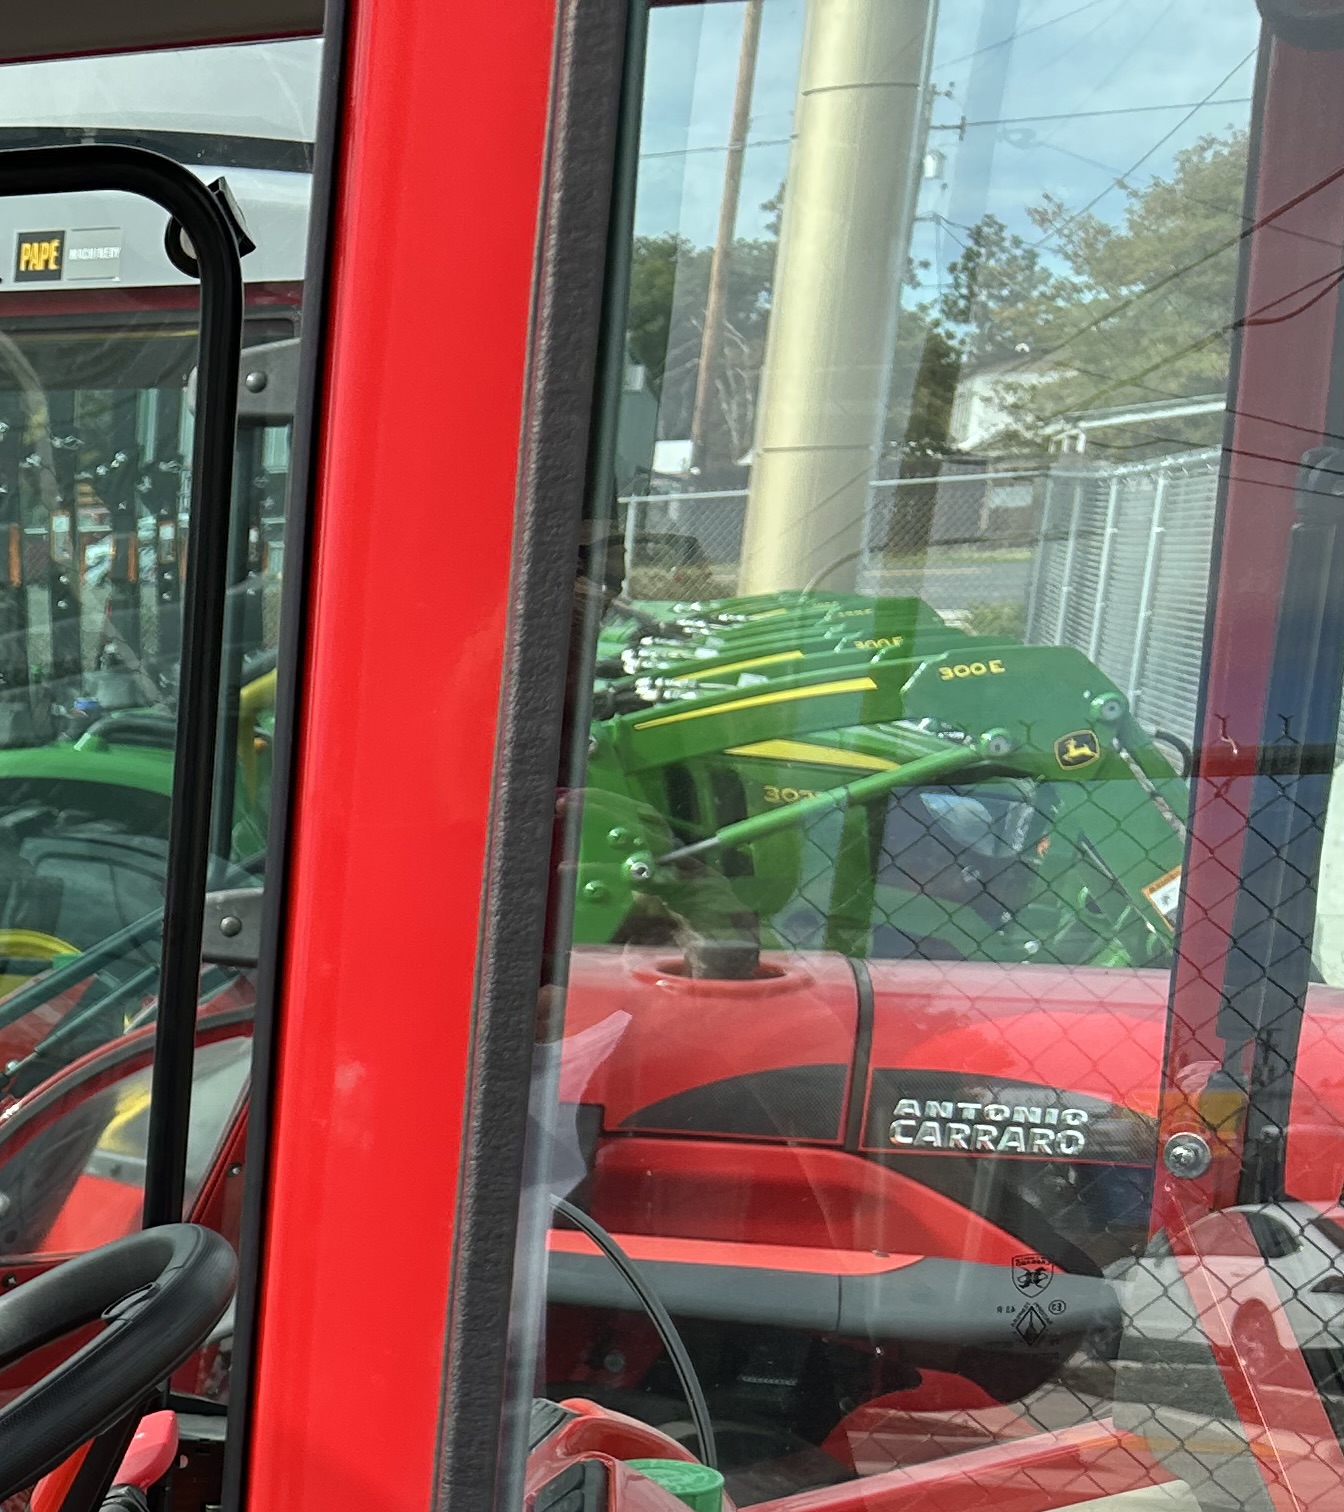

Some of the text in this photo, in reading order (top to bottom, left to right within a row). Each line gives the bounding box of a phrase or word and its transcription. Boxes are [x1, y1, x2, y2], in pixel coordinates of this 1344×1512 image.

[938, 659, 1006, 681] 300E
[893, 1098, 1088, 1127] ANTONIO
[889, 1119, 1086, 1156] CARRARO
